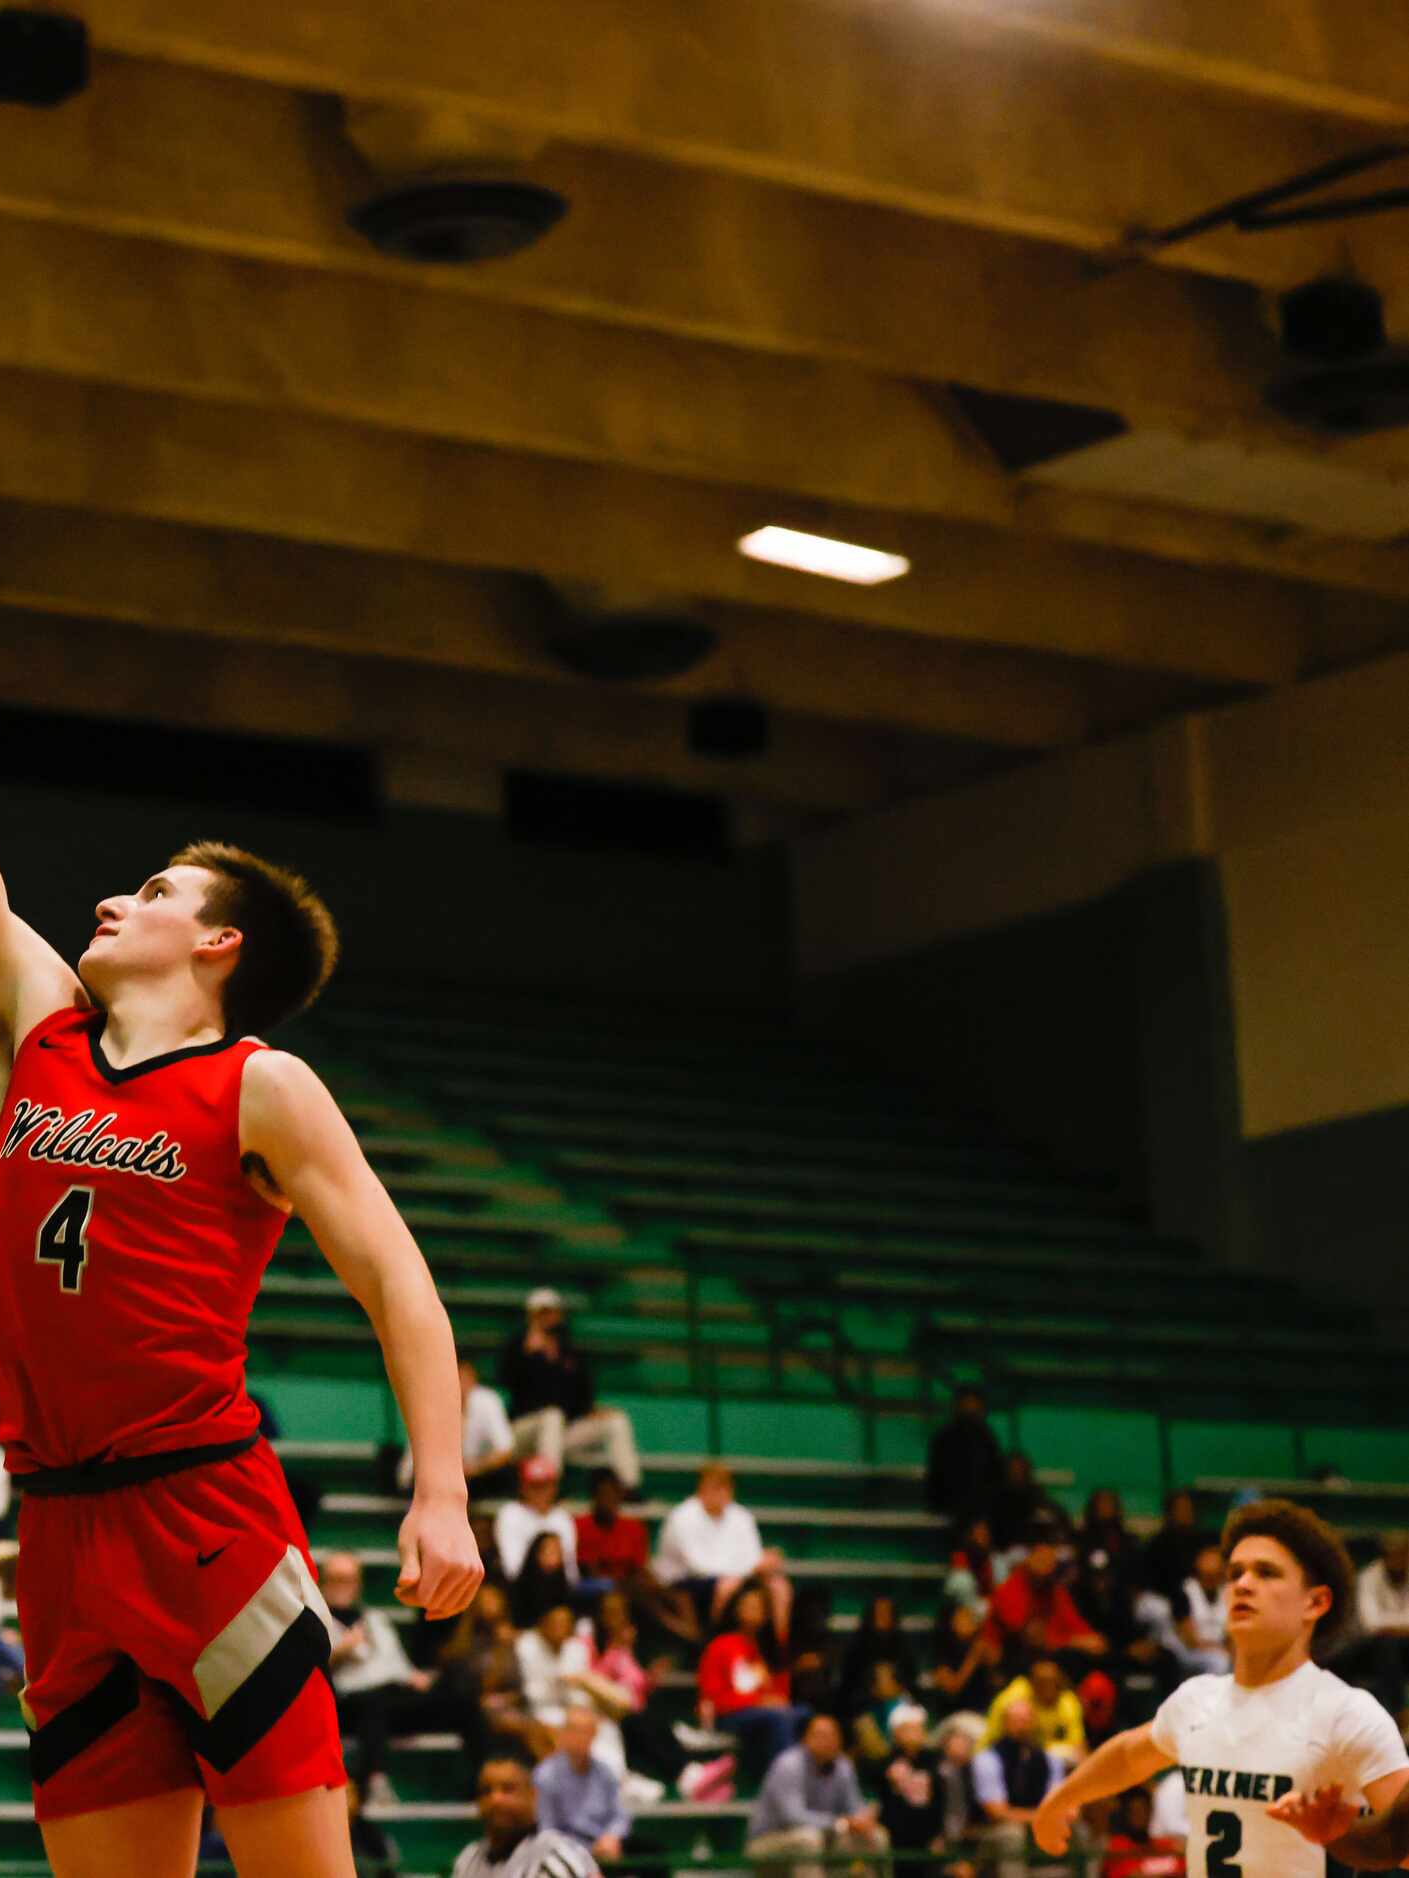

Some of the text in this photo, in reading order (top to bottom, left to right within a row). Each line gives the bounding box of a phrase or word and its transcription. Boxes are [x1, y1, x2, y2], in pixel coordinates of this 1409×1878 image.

[0, 1098, 187, 1183] Wildcats
[35, 1184, 96, 1295] 4
[1206, 1810, 1242, 1878] 2
